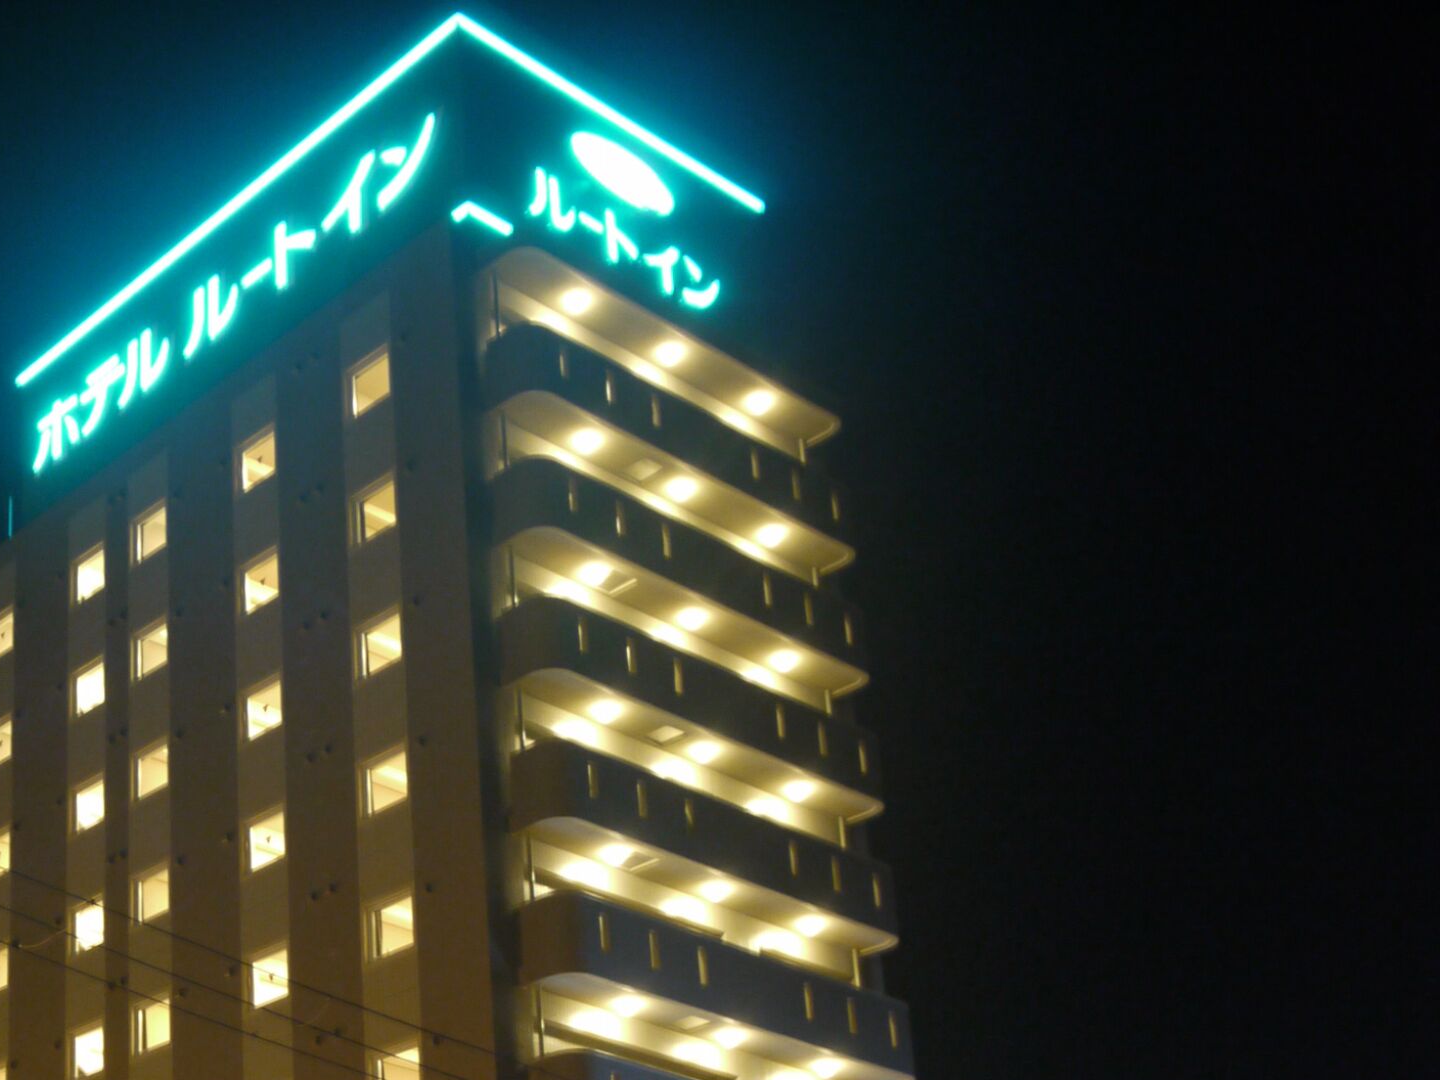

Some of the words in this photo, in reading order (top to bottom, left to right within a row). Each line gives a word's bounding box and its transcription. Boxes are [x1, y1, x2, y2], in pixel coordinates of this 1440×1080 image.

[31, 326, 170, 475] ホテル
[182, 111, 436, 360] ルートイン
[527, 165, 722, 310] ルートイン
